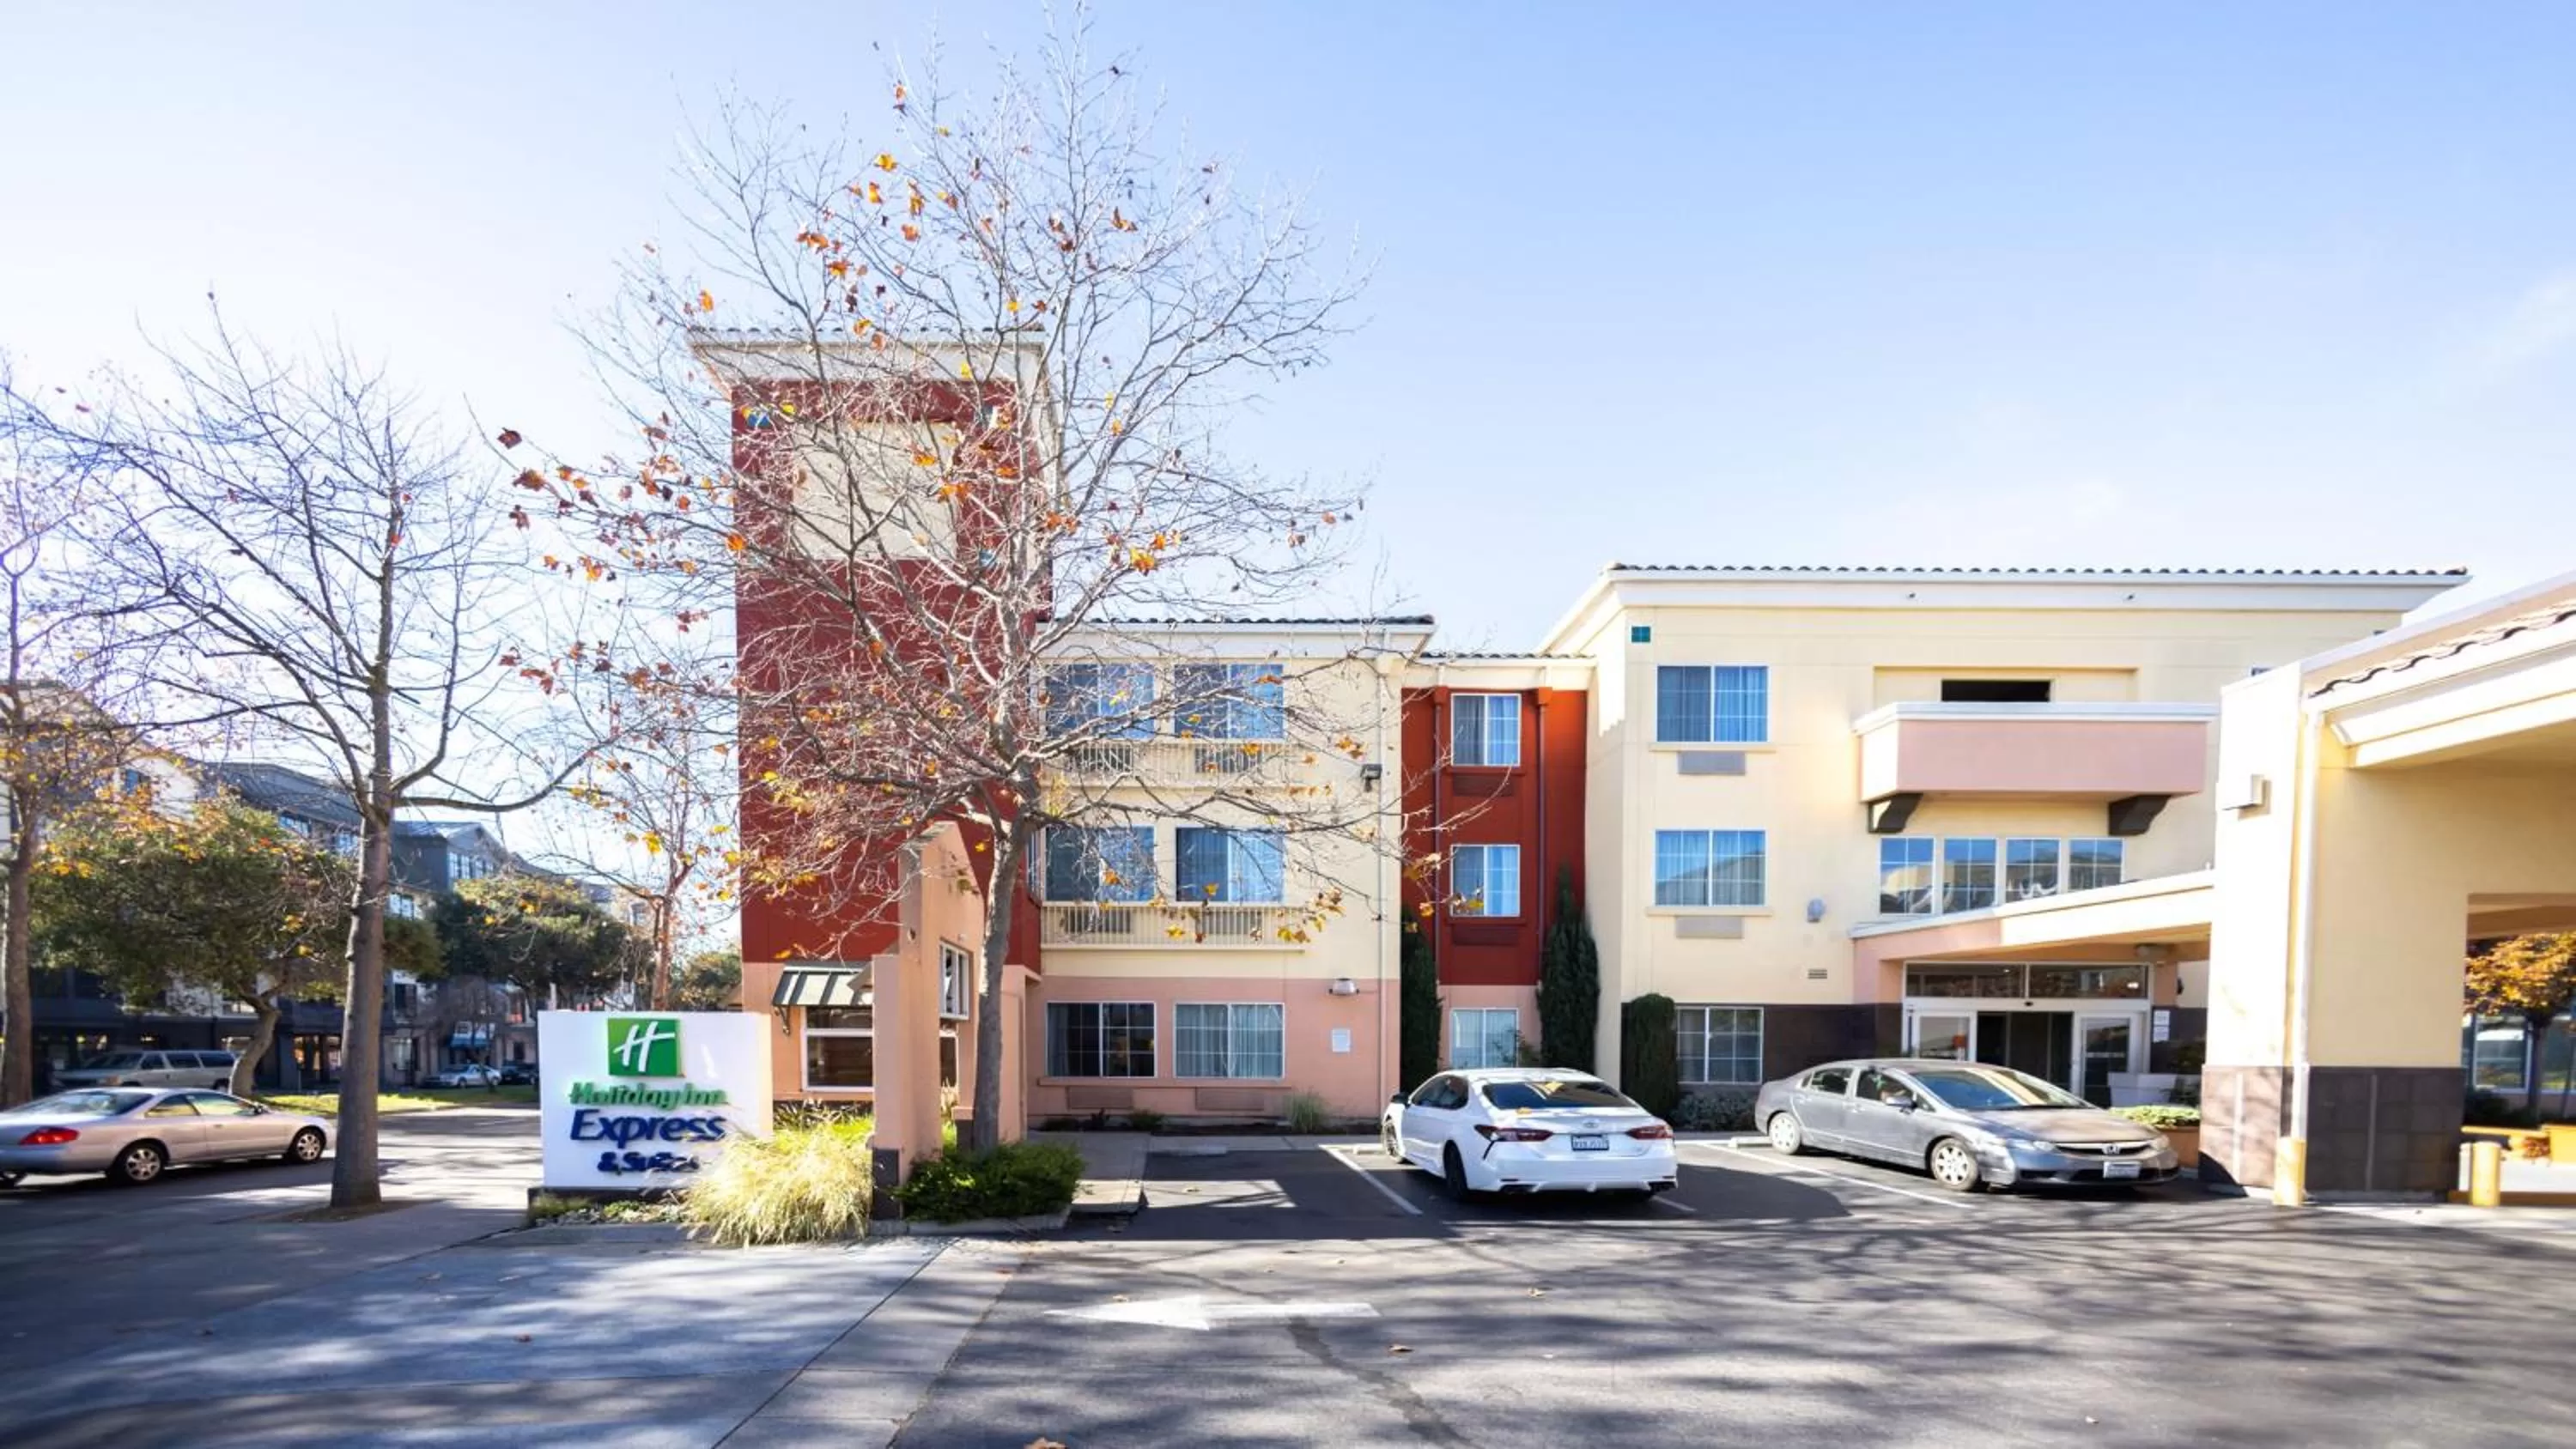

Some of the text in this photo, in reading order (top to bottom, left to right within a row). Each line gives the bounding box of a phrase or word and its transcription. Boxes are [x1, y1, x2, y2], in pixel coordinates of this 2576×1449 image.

[570, 1082, 727, 1111] Holiday Inn
[570, 1109, 726, 1149] Express
[597, 1151, 618, 1173] &
